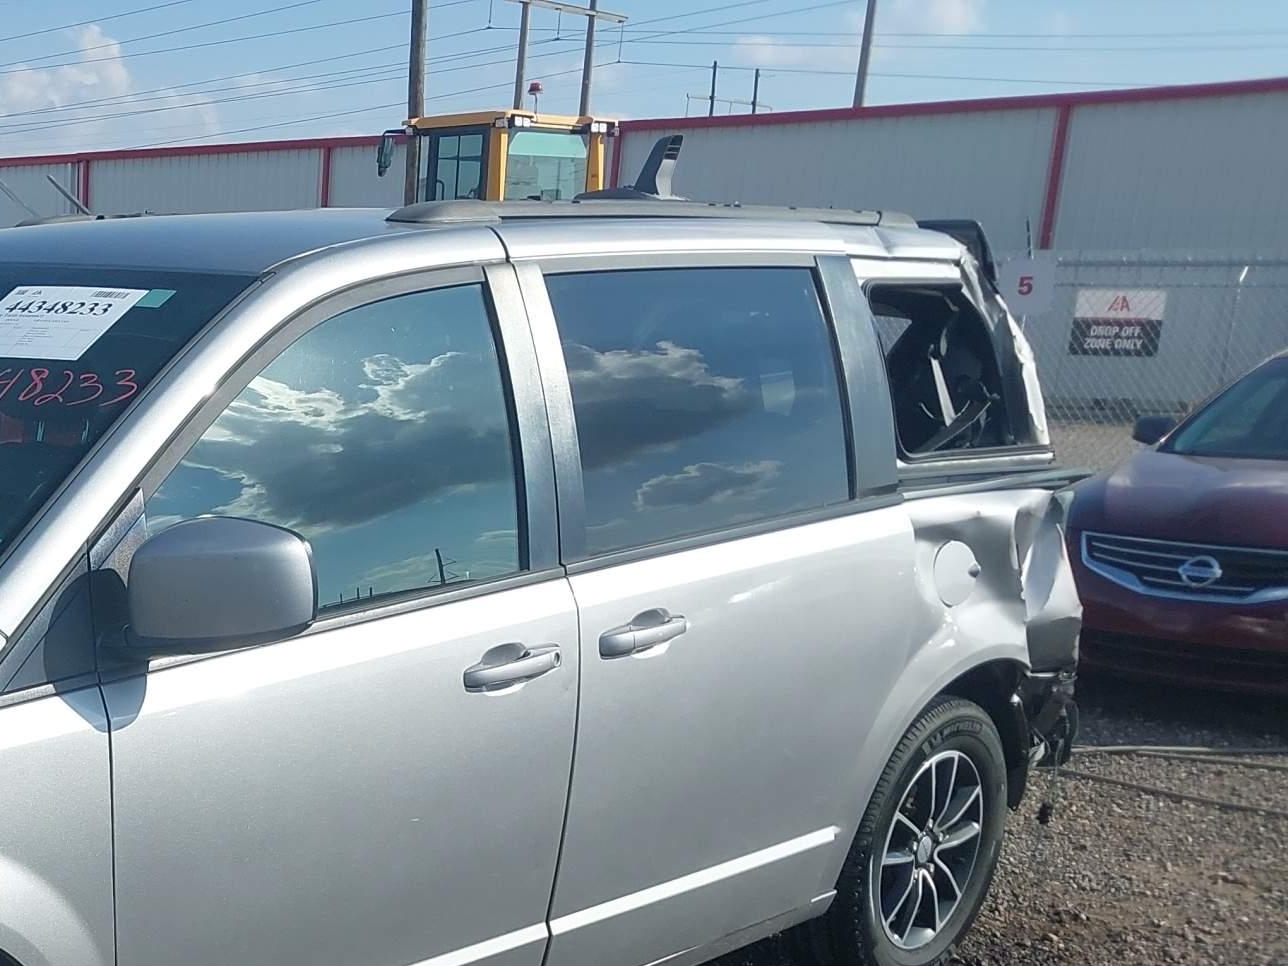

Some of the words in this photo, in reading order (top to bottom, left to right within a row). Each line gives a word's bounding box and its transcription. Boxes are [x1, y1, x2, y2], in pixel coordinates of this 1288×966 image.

[1018, 276, 1033, 295] 5
[6, 300, 113, 316] 44348233
[1090, 325, 1119, 337] DROP
[1121, 326, 1142, 337] OFF
[1083, 337, 1112, 349] ZONE
[1114, 338, 1143, 349] ONLY
